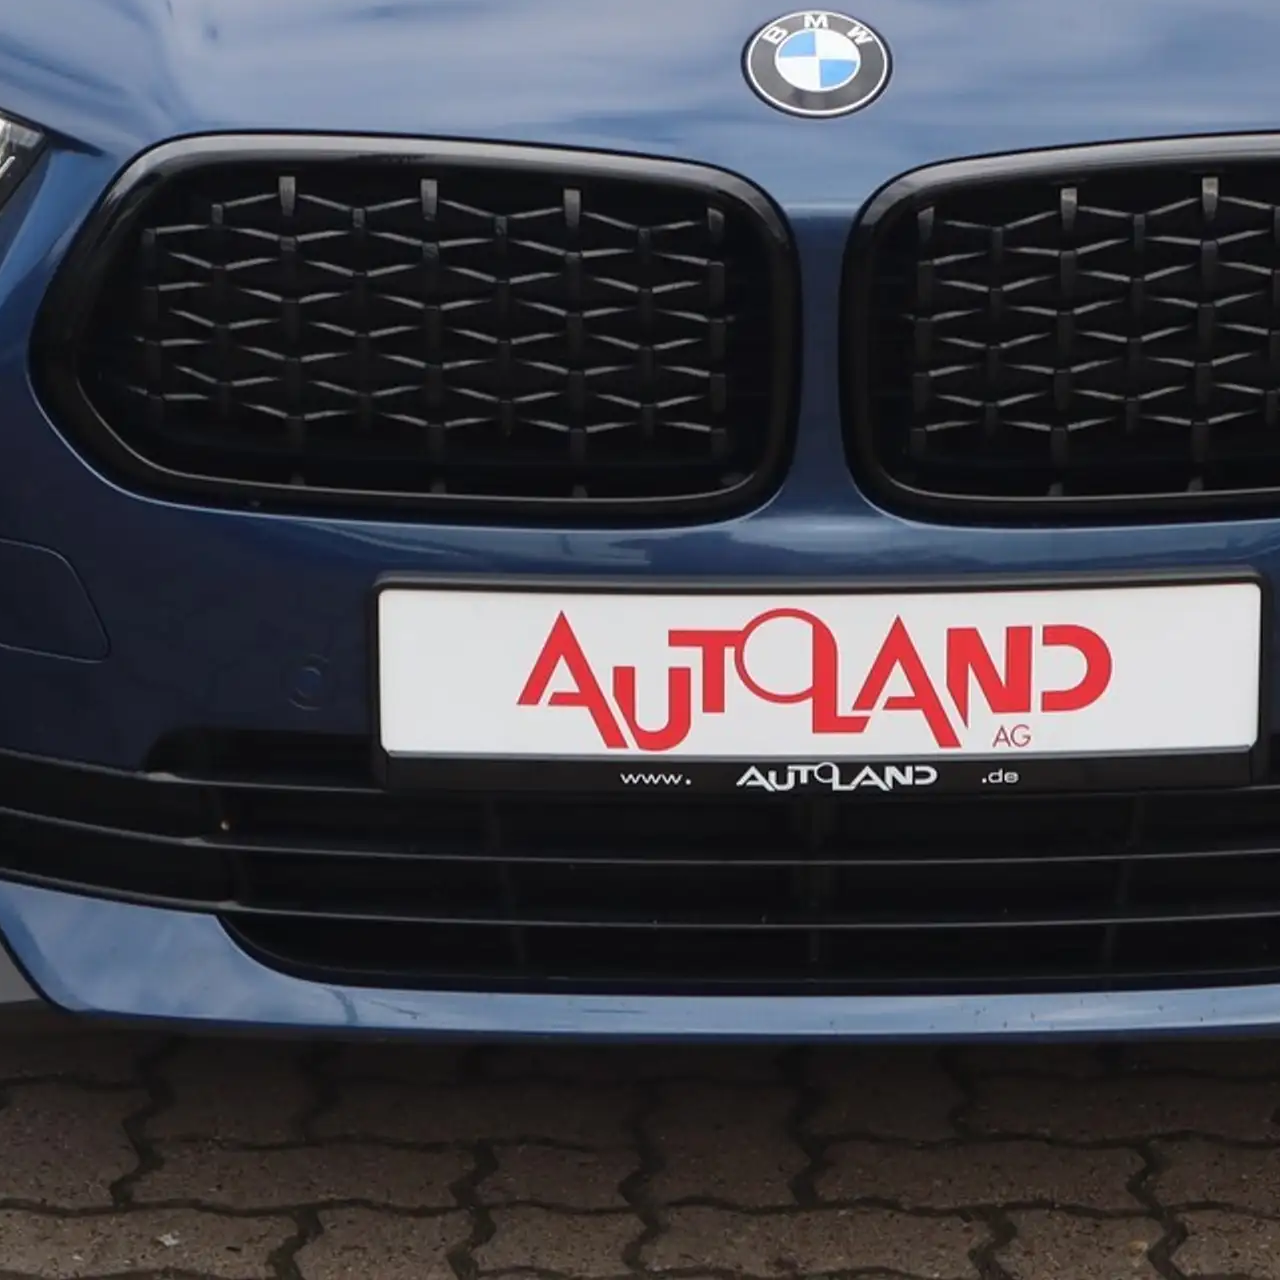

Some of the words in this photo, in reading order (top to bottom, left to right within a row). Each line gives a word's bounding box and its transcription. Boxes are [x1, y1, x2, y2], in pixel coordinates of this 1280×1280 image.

[762, 13, 873, 45] BMW
[993, 724, 1031, 748] AG
[620, 771, 692, 786] www.
[981, 767, 1019, 784] .de
